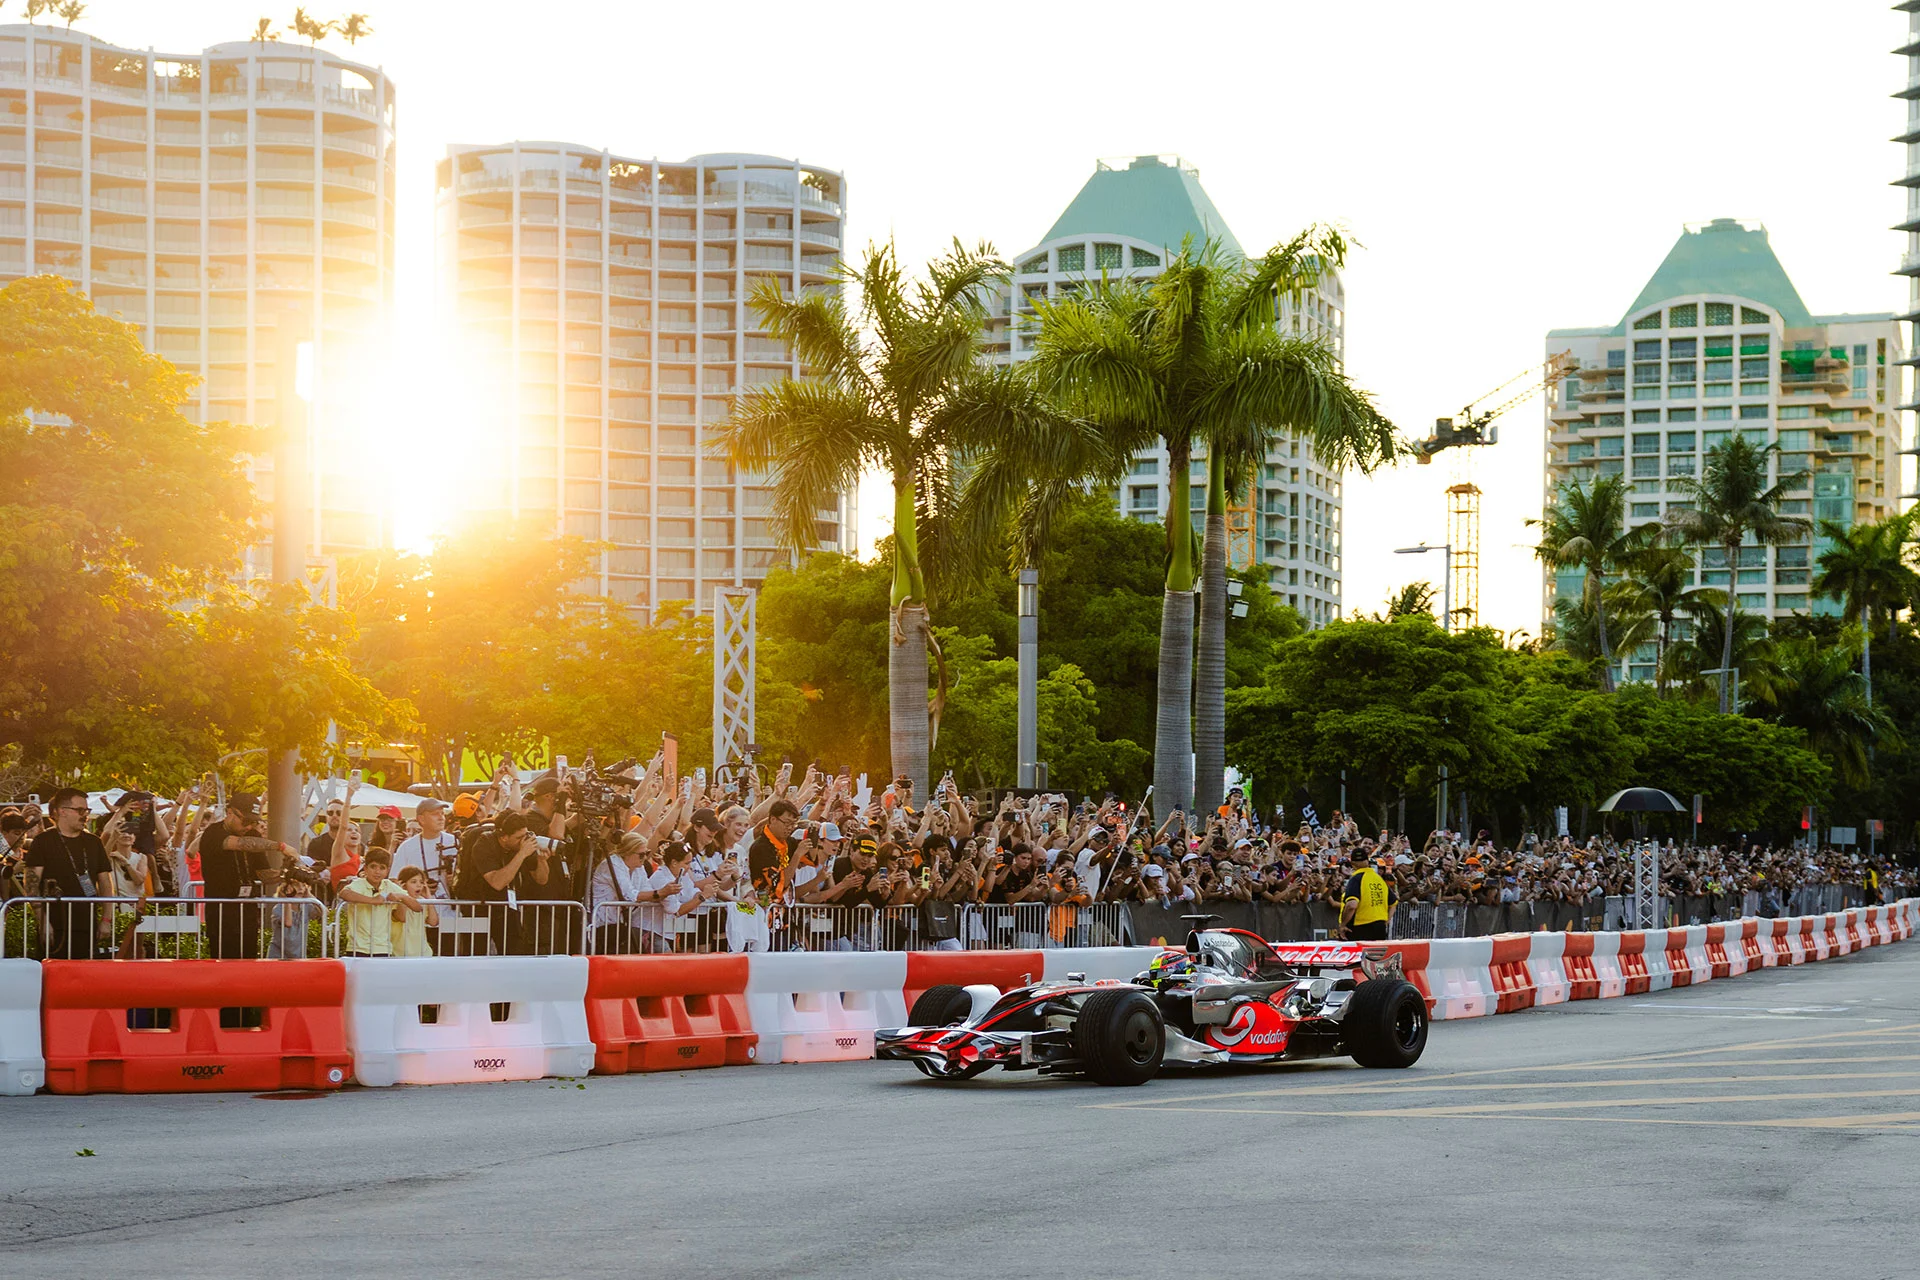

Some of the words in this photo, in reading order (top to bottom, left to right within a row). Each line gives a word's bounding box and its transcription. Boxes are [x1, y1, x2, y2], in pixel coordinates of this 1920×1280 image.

[1369, 883, 1382, 891] CSC
[1277, 945, 1361, 962] vodafon
[474, 1059, 506, 1068] YODOCK
[181, 1064, 226, 1076] YODOCK
